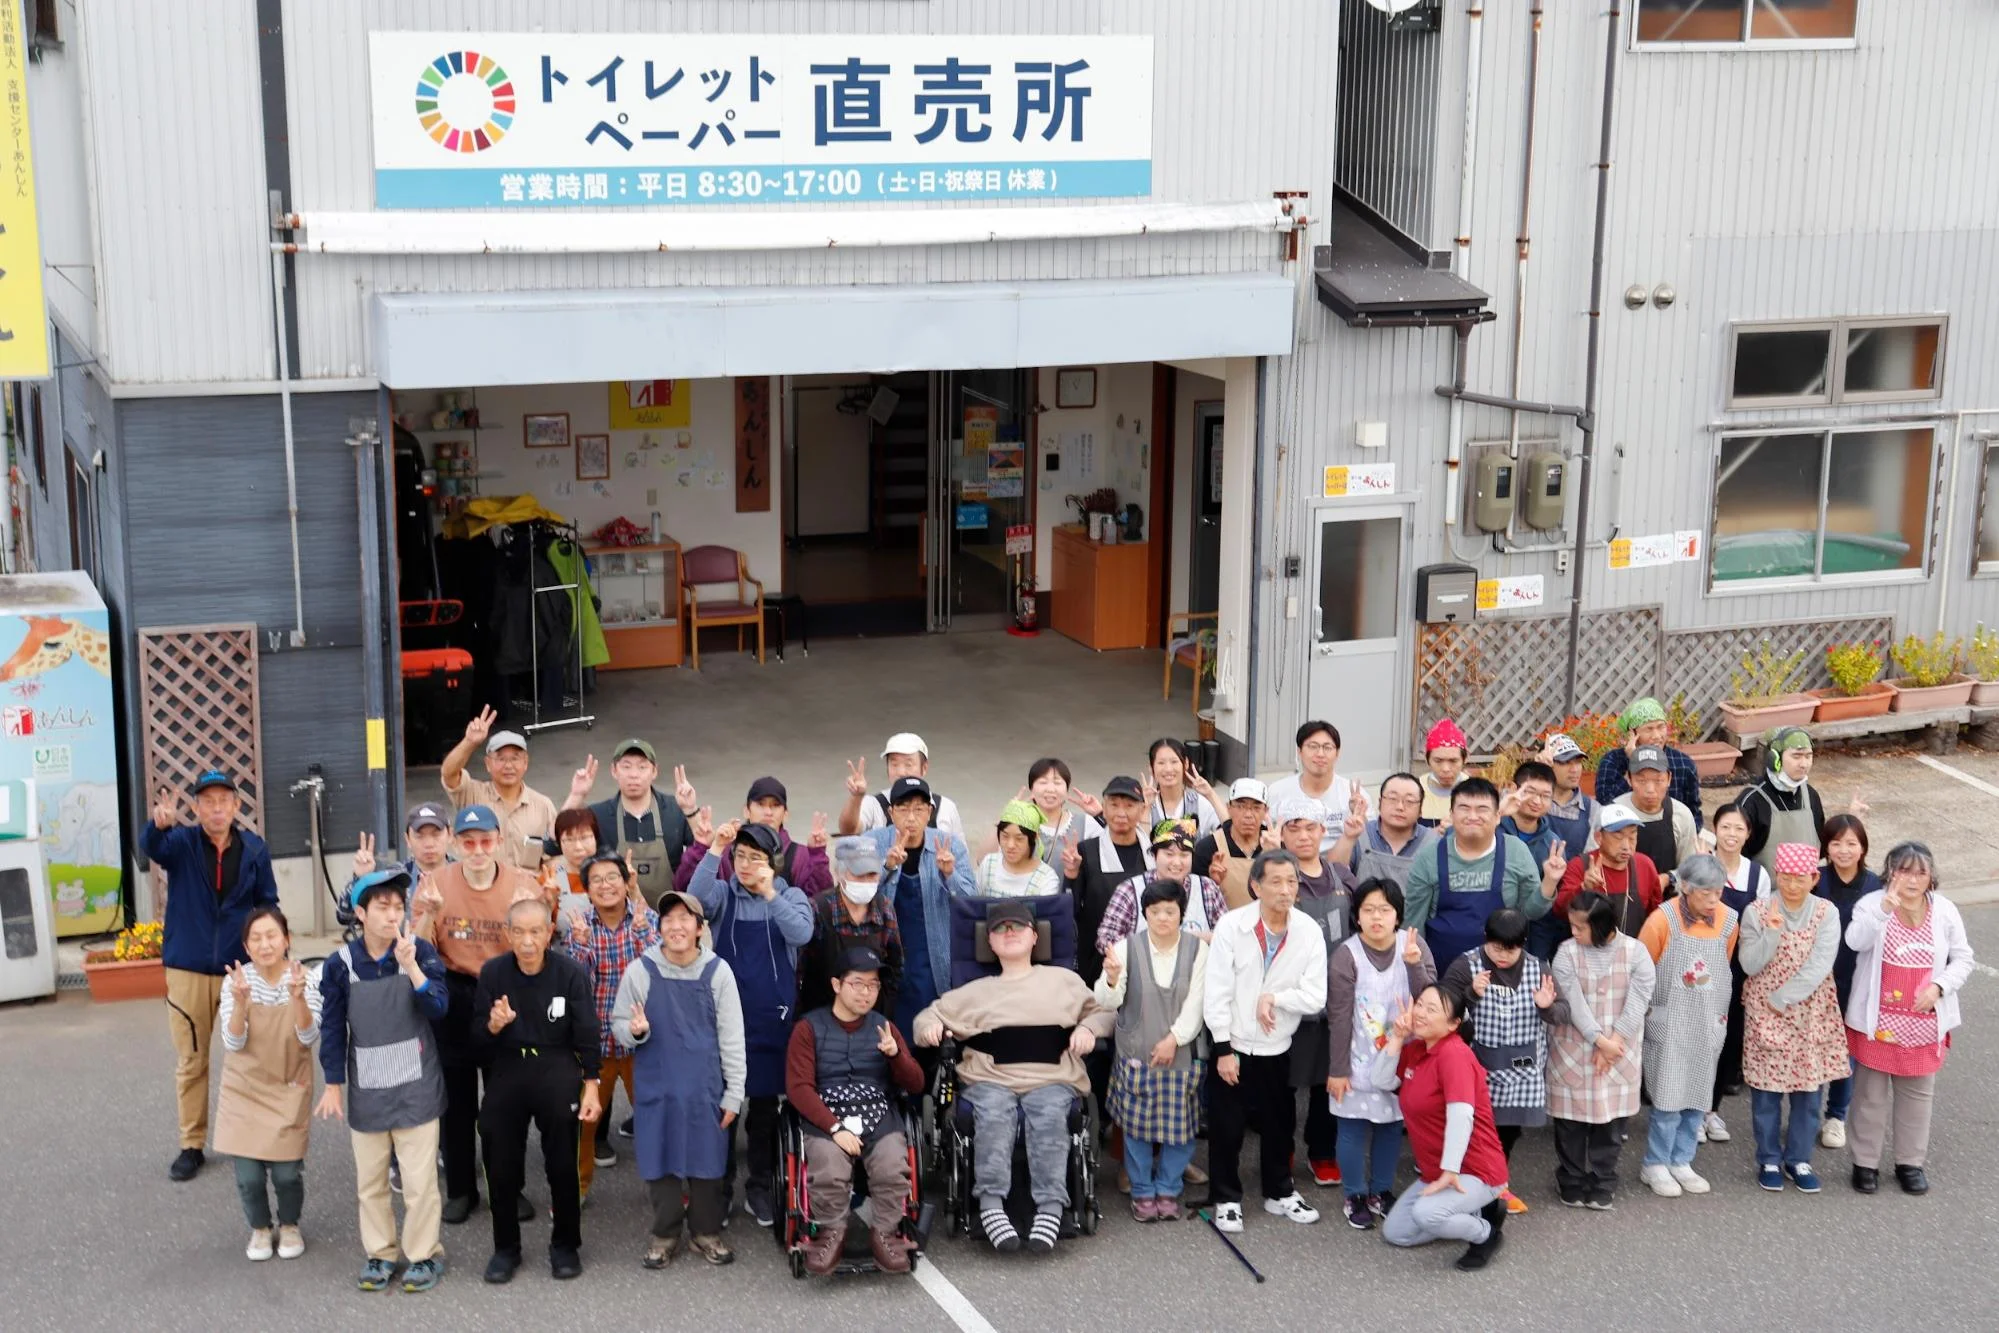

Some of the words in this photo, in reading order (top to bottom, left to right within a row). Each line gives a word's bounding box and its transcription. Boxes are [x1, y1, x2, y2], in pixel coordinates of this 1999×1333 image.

[541, 55, 775, 103] トイレット
[810, 57, 1092, 146] 直売所
[585, 109, 780, 151] ペーパー
